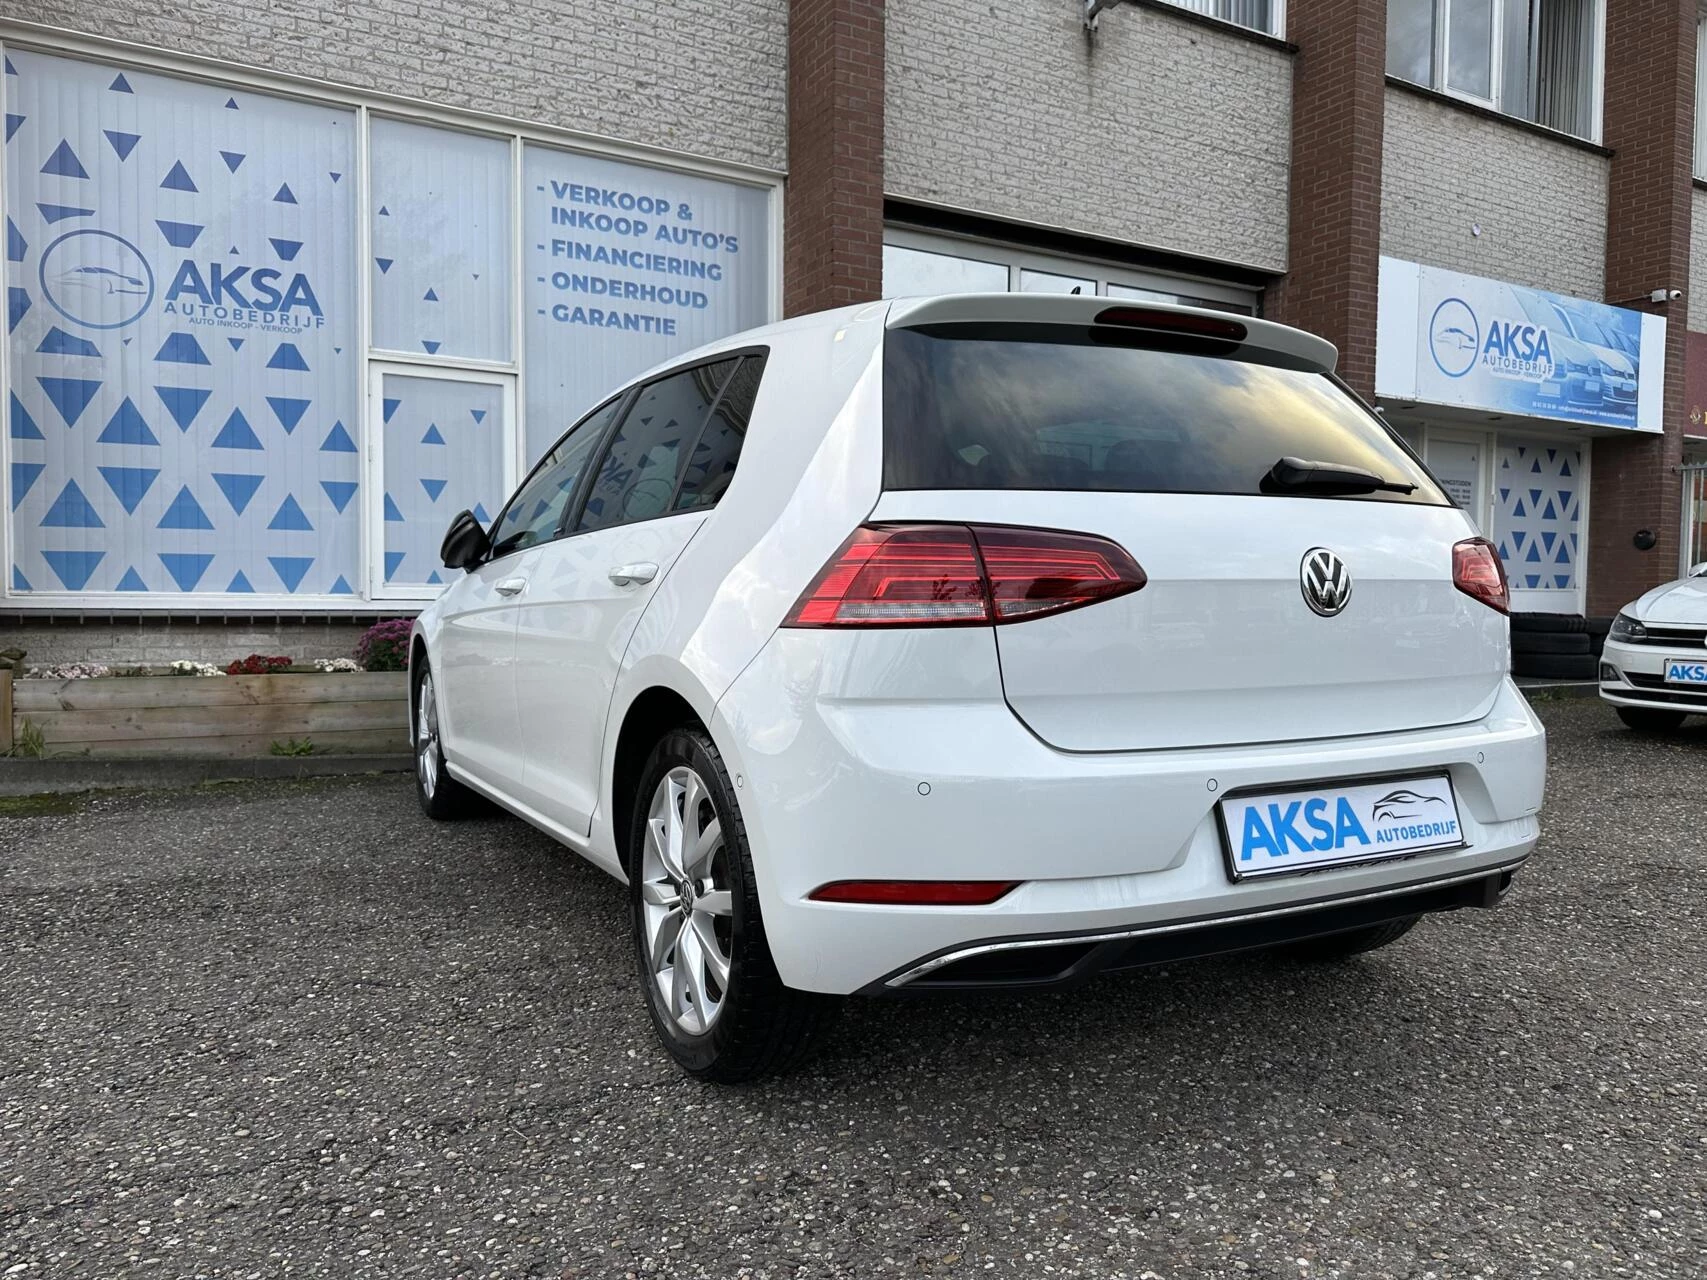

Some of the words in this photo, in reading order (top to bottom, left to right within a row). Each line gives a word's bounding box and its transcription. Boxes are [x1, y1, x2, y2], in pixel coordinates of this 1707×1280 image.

[550, 180, 671, 216] VERKOOP
[677, 203, 693, 221] &
[551, 206, 648, 237] INKOOP
[655, 224, 739, 253] AUTO'S
[551, 239, 722, 281] FINANCIERING
[165, 259, 324, 317] AKSA
[551, 271, 708, 309] ONDERHOUD
[164, 301, 325, 329] AUTOBEDRIJF
[189, 317, 215, 326] AUTO
[217, 320, 253, 329] INKOOP
[260, 324, 303, 334] VERKOOP
[552, 303, 676, 336] GARANTIE
[1483, 320, 1552, 365] AKSA
[1482, 354, 1553, 375] AUTOBEDRIJF
[1669, 665, 1707, 681] AKS
[1241, 796, 1371, 861] AKSA
[1376, 820, 1456, 843] AUTOBEDRIJF
